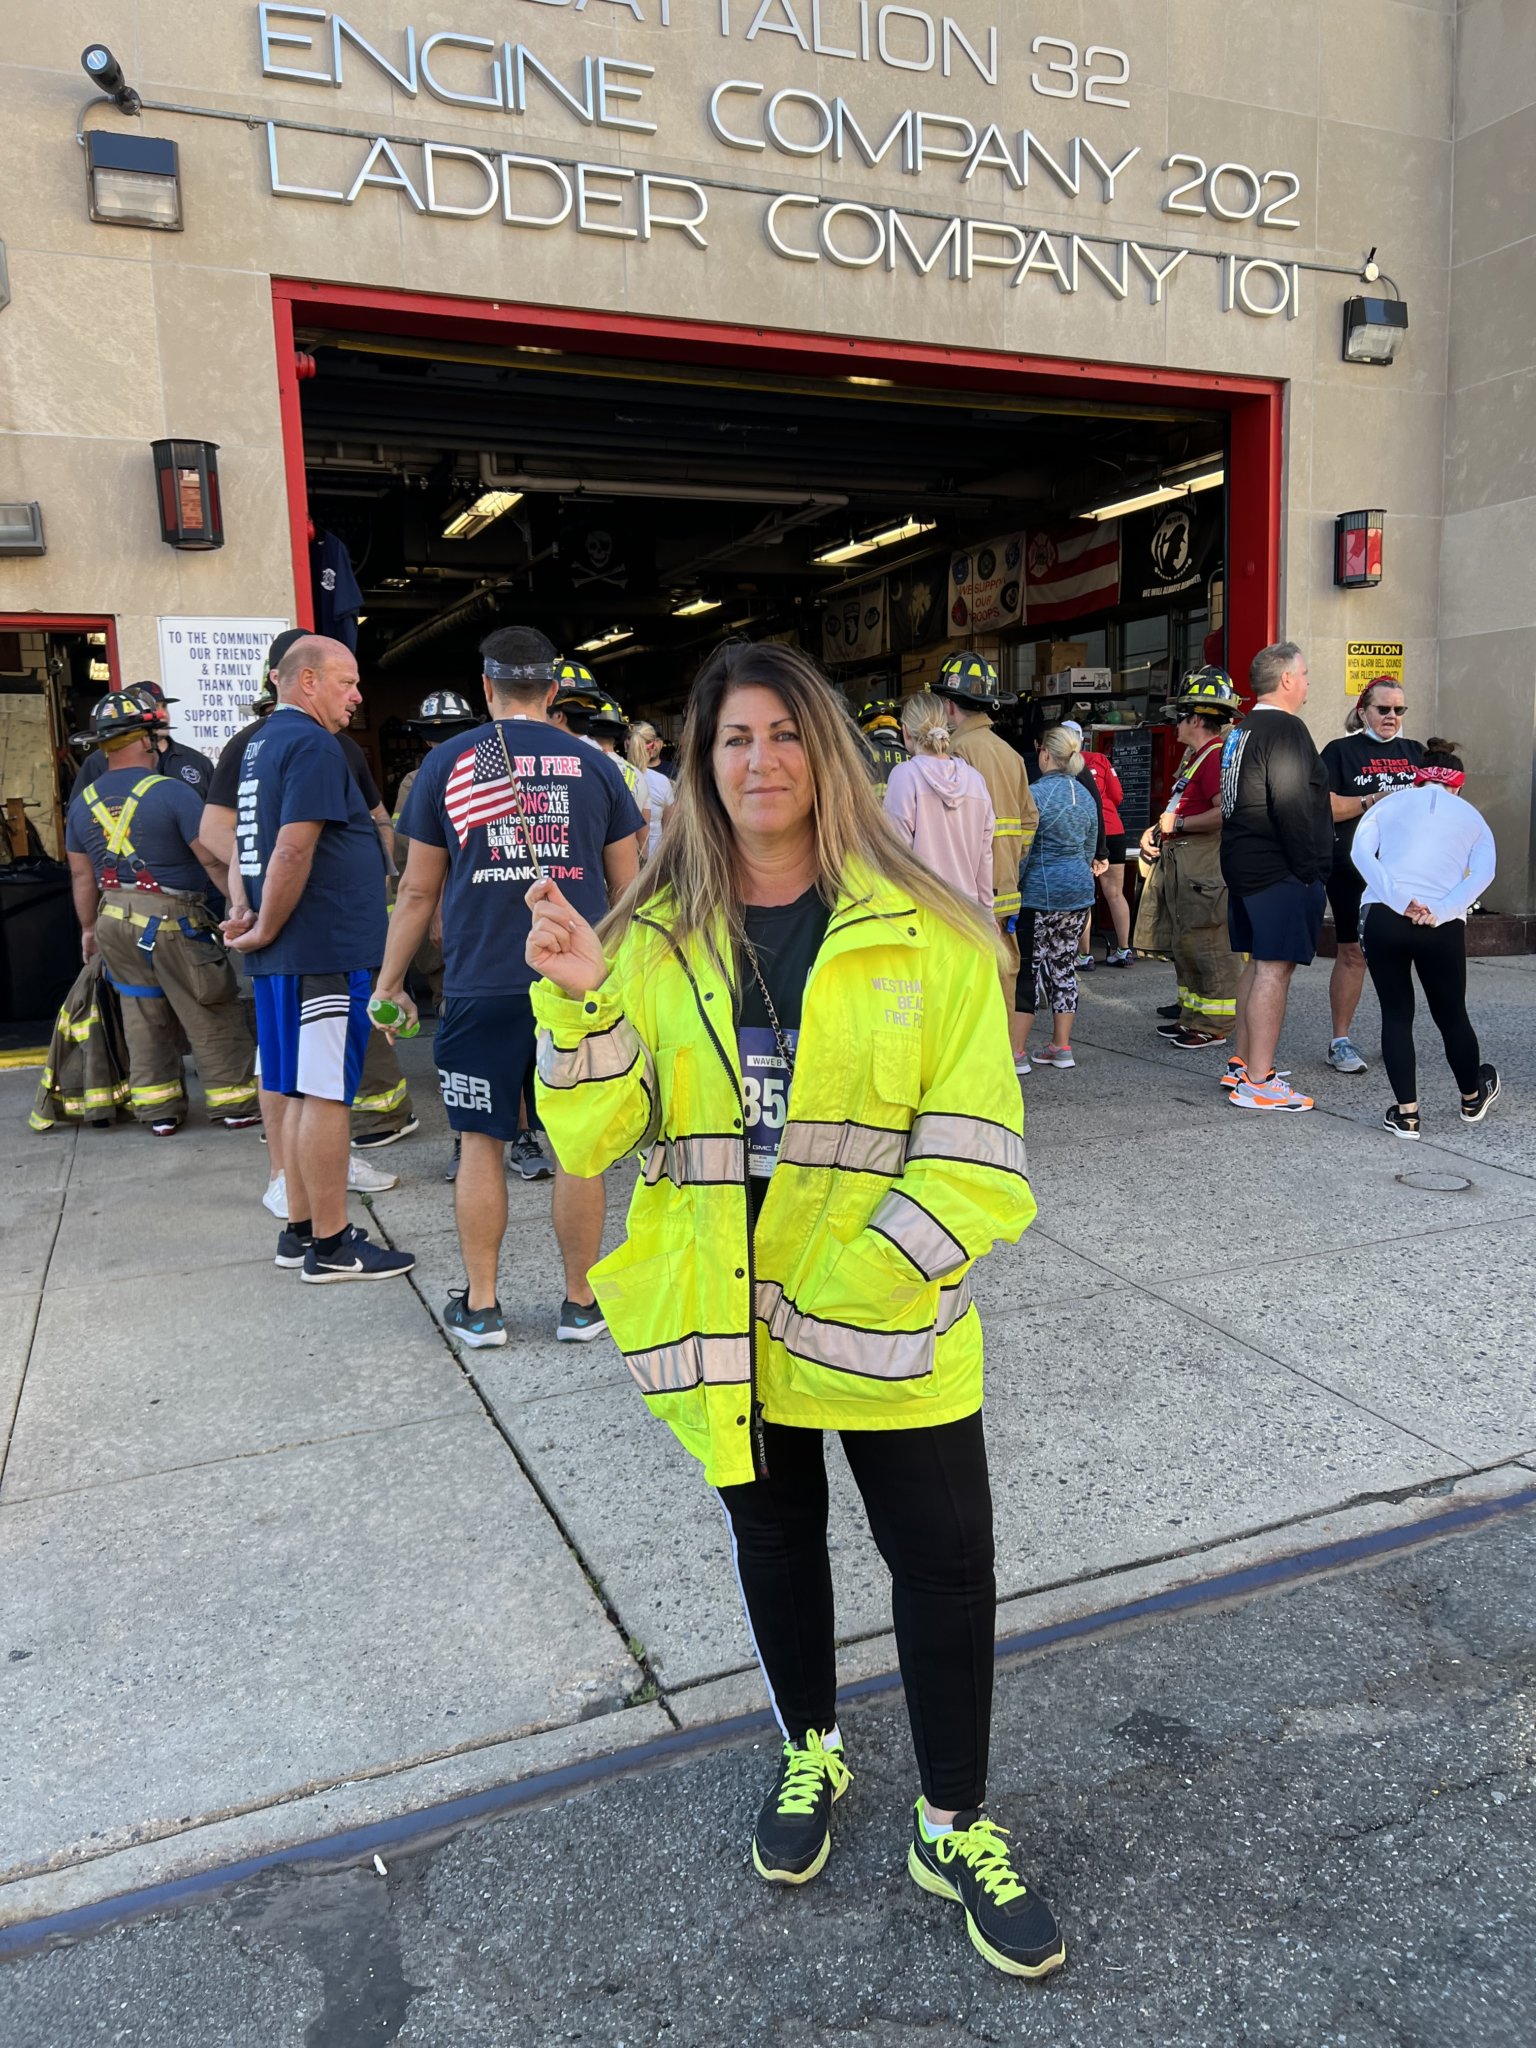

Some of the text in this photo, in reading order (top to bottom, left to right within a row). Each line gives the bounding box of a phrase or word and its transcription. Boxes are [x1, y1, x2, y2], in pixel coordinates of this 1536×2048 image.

[1031, 36, 1130, 108] 32
[259, 2, 1301, 230] ENGINE COMPANY 202
[267, 121, 1299, 320] LADDER COMPANY 101
[168, 631, 276, 645] TO THE COMMUNITY
[189, 647, 262, 661] OUR FRIENDS
[1350, 645, 1400, 655] CAUTION
[201, 663, 252, 676] & FAMILY
[198, 679, 258, 692] THANK YOU
[202, 694, 255, 707] FOR YOUR
[184, 709, 233, 722] SUPPORT
[193, 725, 218, 738] TIME
[224, 725, 237, 738] OF
[540, 755, 583, 778] FIRE
[1370, 758, 1410, 767] RETIRED
[1354, 774, 1373, 786] Not
[1376, 772, 1394, 785] My
[526, 784, 549, 793] know
[550, 781, 569, 792] how
[547, 791, 569, 802] WE
[547, 802, 569, 814] ARE
[509, 814, 537, 826] beng
[538, 814, 570, 826] strong
[487, 824, 516, 836] is the
[504, 843, 570, 860] WE HAVE
[472, 865, 584, 883] #FRANKETIME
[884, 1008, 912, 1028] FIRE
[752, 1057, 783, 1067] WAVE B
[438, 1068, 491, 1100] DER
[442, 1089, 493, 1115] OUR
[742, 1076, 791, 1129] 85
